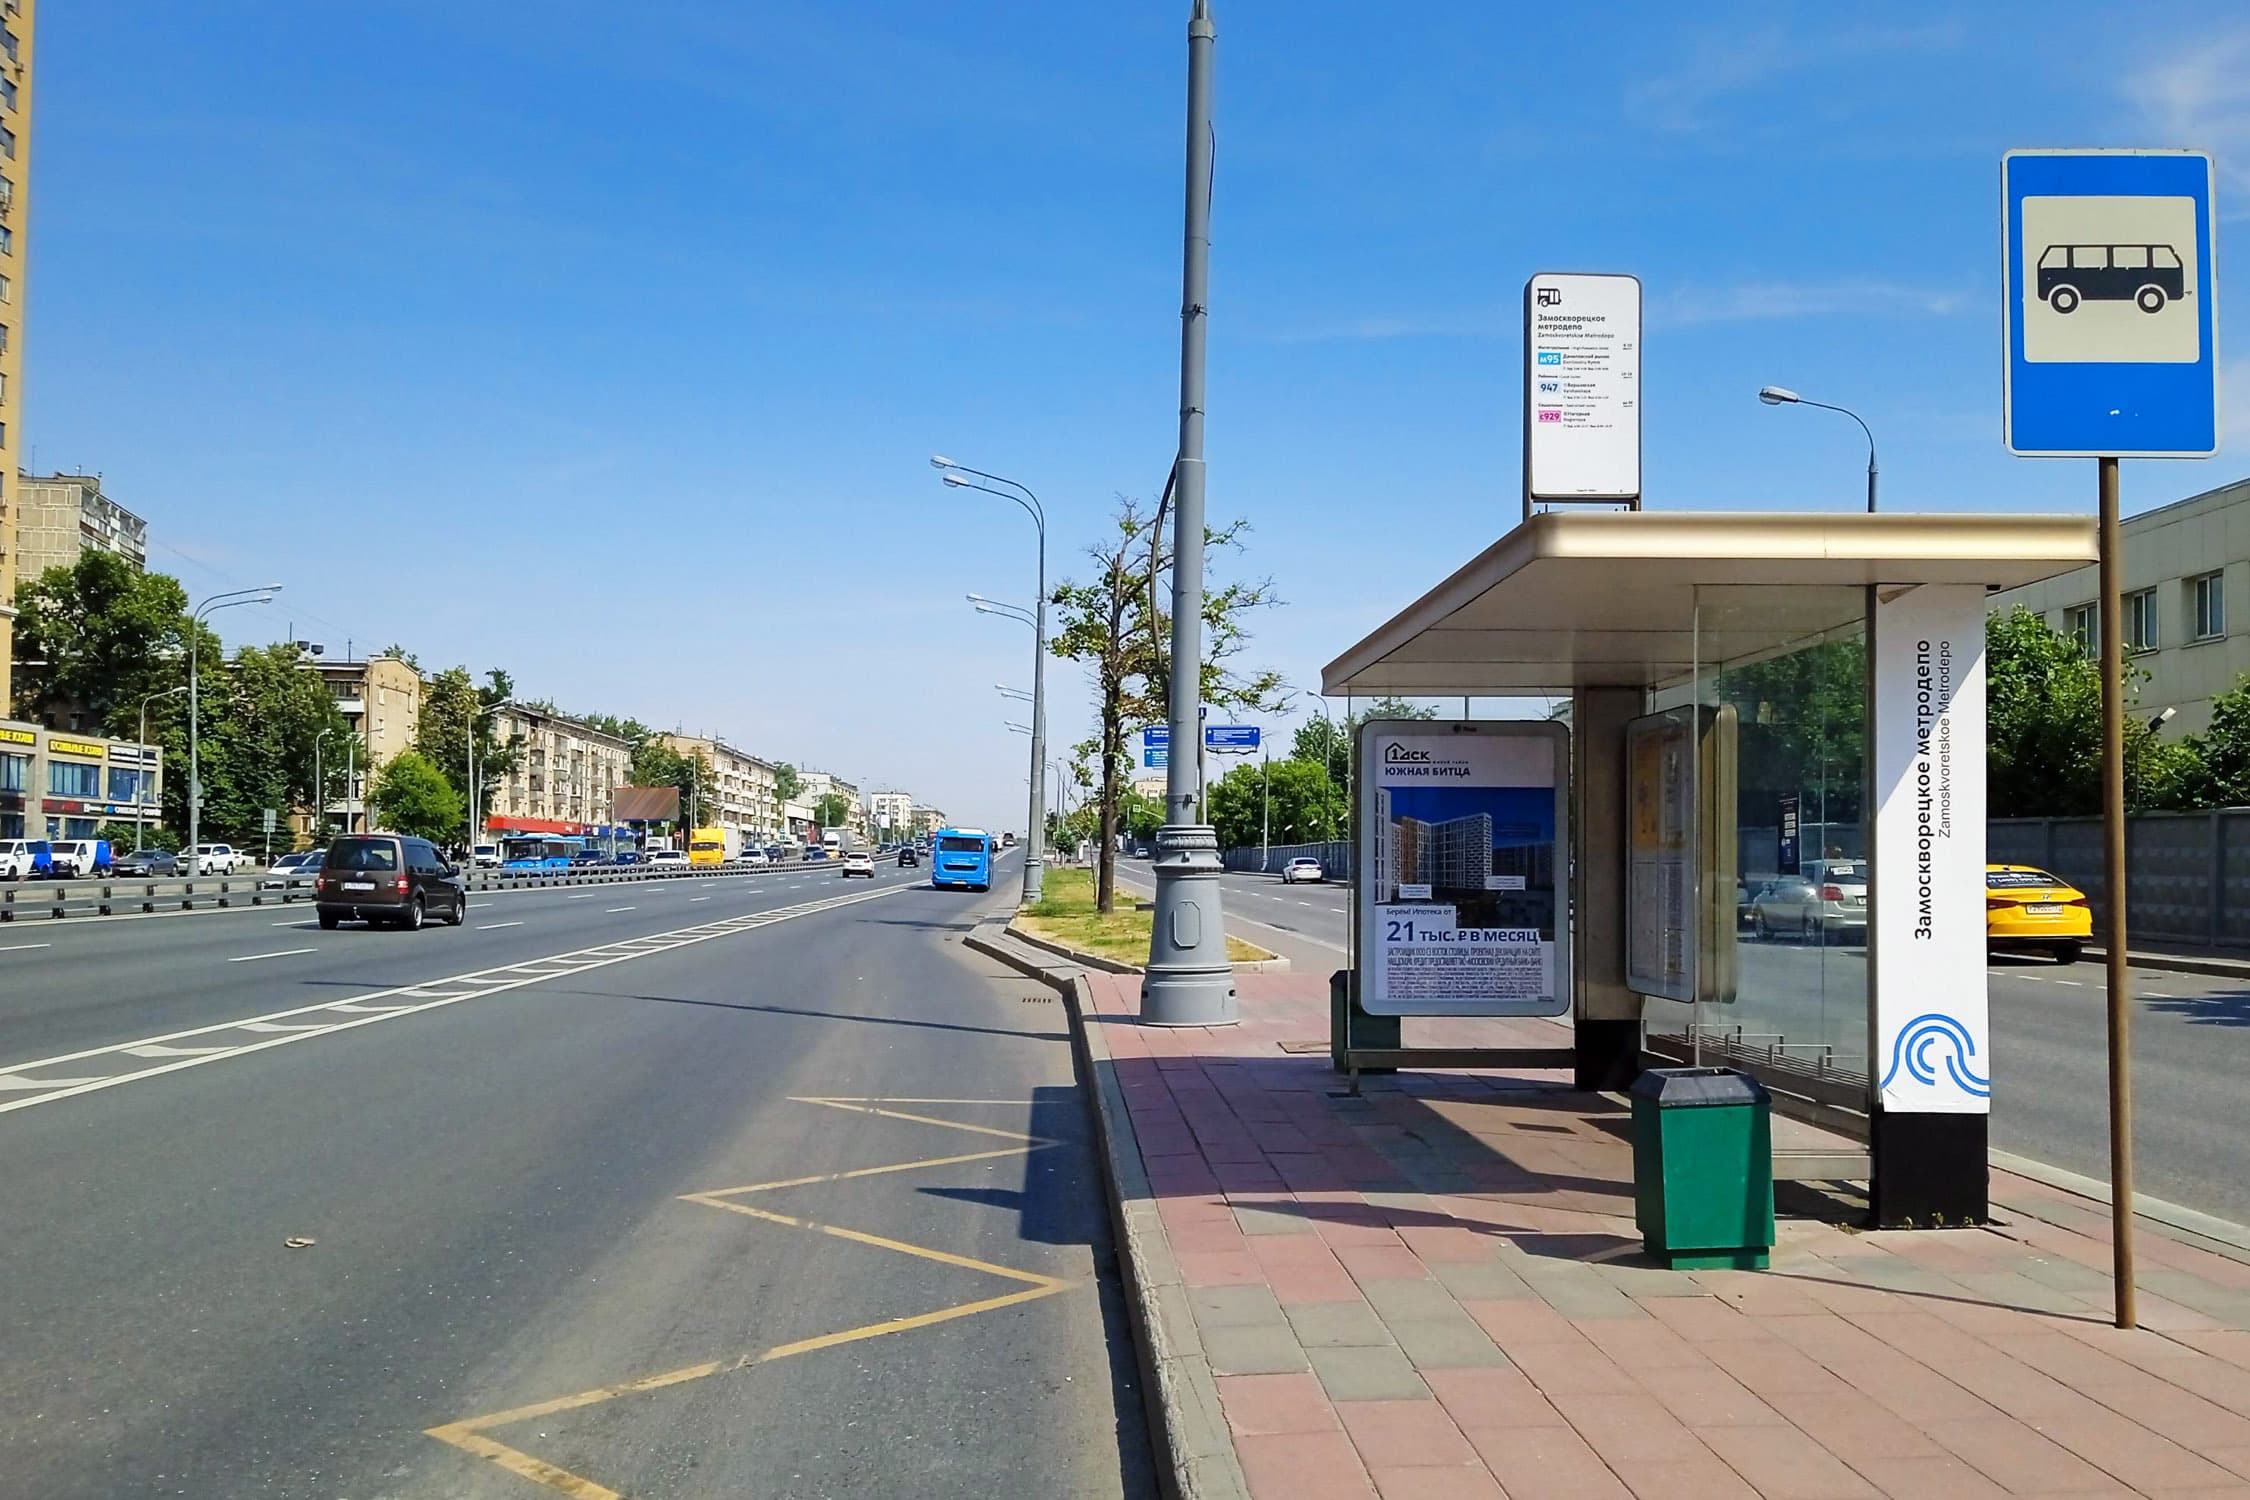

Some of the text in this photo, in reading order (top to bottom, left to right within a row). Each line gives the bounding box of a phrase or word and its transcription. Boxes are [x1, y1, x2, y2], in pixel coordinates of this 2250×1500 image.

[1537, 314, 1606, 323] Замоскворецкое
[1537, 324, 1583, 332] метродепо
[1540, 383, 1558, 392] 947
[1938, 640, 1953, 839] Zamoskvoretskoe Metrodepo
[1385, 767, 1471, 778] ЮЖНАЯ БИТЦА
[1915, 639, 1935, 940] Замоскворецкое метродепо
[1386, 920, 1414, 942] 21
[1419, 930, 1455, 942] тыс.
[1470, 930, 1479, 942] в
[1484, 930, 1539, 945] месяц
